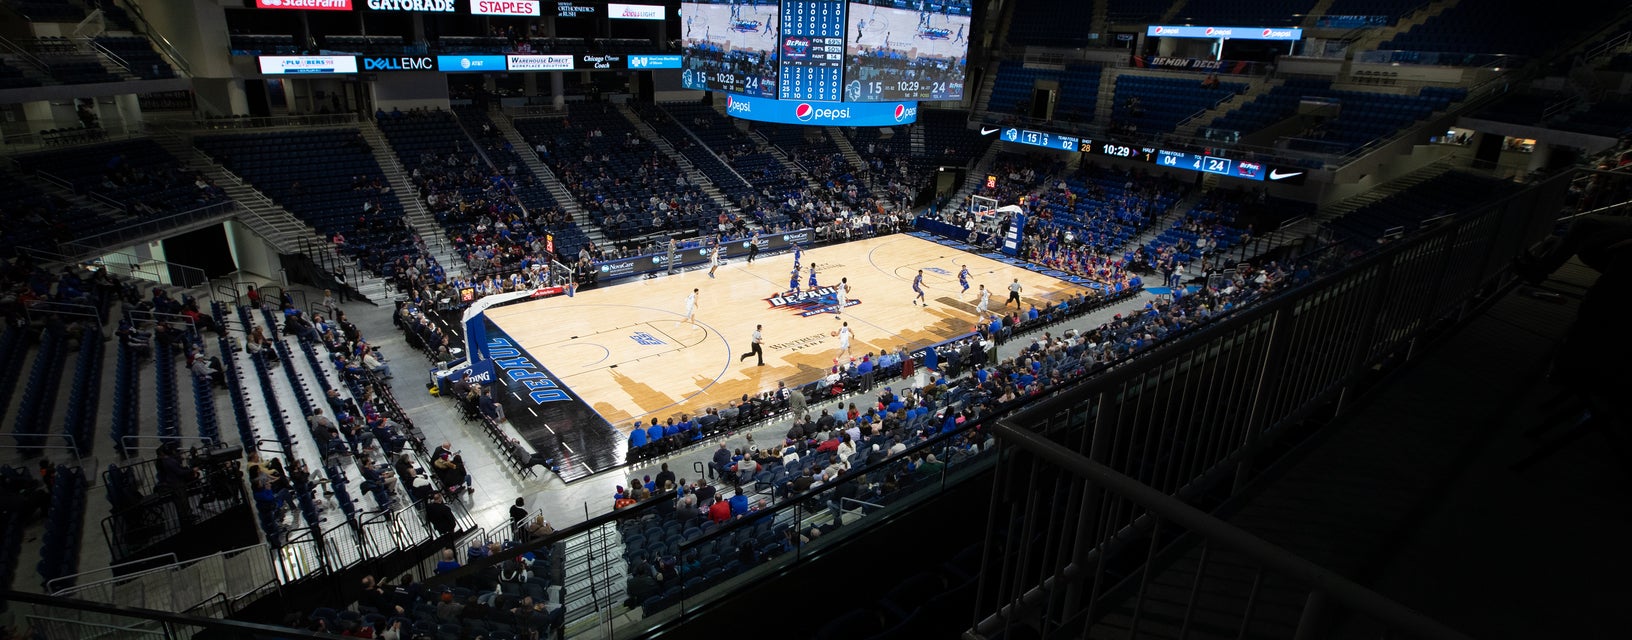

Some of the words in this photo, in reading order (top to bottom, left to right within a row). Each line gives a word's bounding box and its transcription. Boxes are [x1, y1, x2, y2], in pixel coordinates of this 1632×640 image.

[367, 0, 454, 12] GATORADE
[480, 1, 532, 14] STAPLES
[1152, 57, 1188, 67] DEMON
[1192, 60, 1223, 69] DECK
[697, 72, 706, 83] 15
[717, 73, 734, 84] 10:29
[746, 77, 758, 89] 24
[869, 82, 882, 94] 15
[897, 81, 919, 91] 10:29
[932, 82, 945, 93] 24
[732, 101, 751, 112] pepsi
[815, 107, 850, 120] pepsi
[1027, 134, 1037, 142] 15
[1062, 141, 1072, 150] 02
[1081, 144, 1091, 152] 28
[1103, 144, 1130, 157] 10:29
[1164, 156, 1176, 165] 04
[1193, 160, 1200, 168] 4
[1209, 160, 1224, 171] 24
[610, 262, 634, 270] NovaCare
[769, 333, 826, 350] WINTRUST
[791, 340, 824, 352] ARENA
[488, 337, 573, 405] DEPAUL
